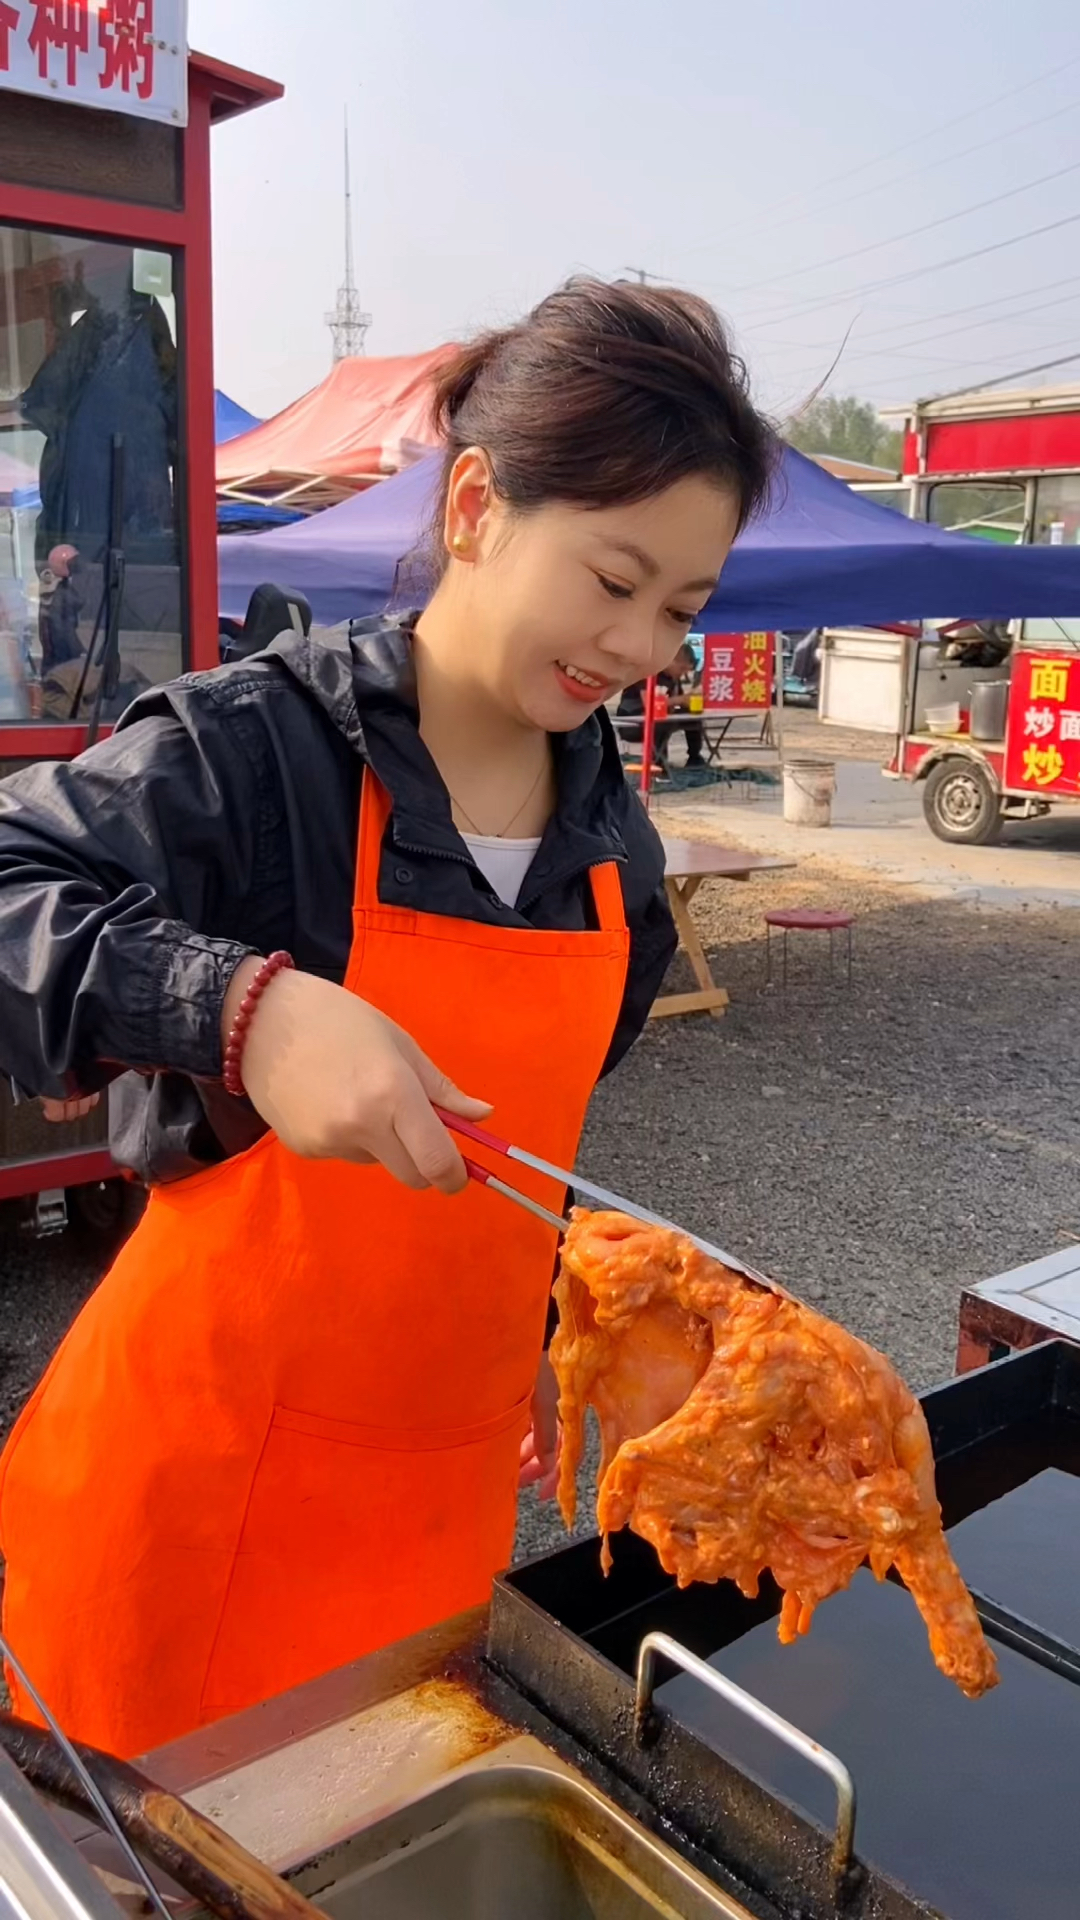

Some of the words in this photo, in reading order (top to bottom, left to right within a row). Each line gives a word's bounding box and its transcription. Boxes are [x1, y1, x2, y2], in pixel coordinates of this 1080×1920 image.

[710, 647, 735, 701] 豆浆
[1030, 659, 1071, 702] 面
[1023, 706, 1080, 741] 炒面
[1022, 743, 1080, 785] 炒
